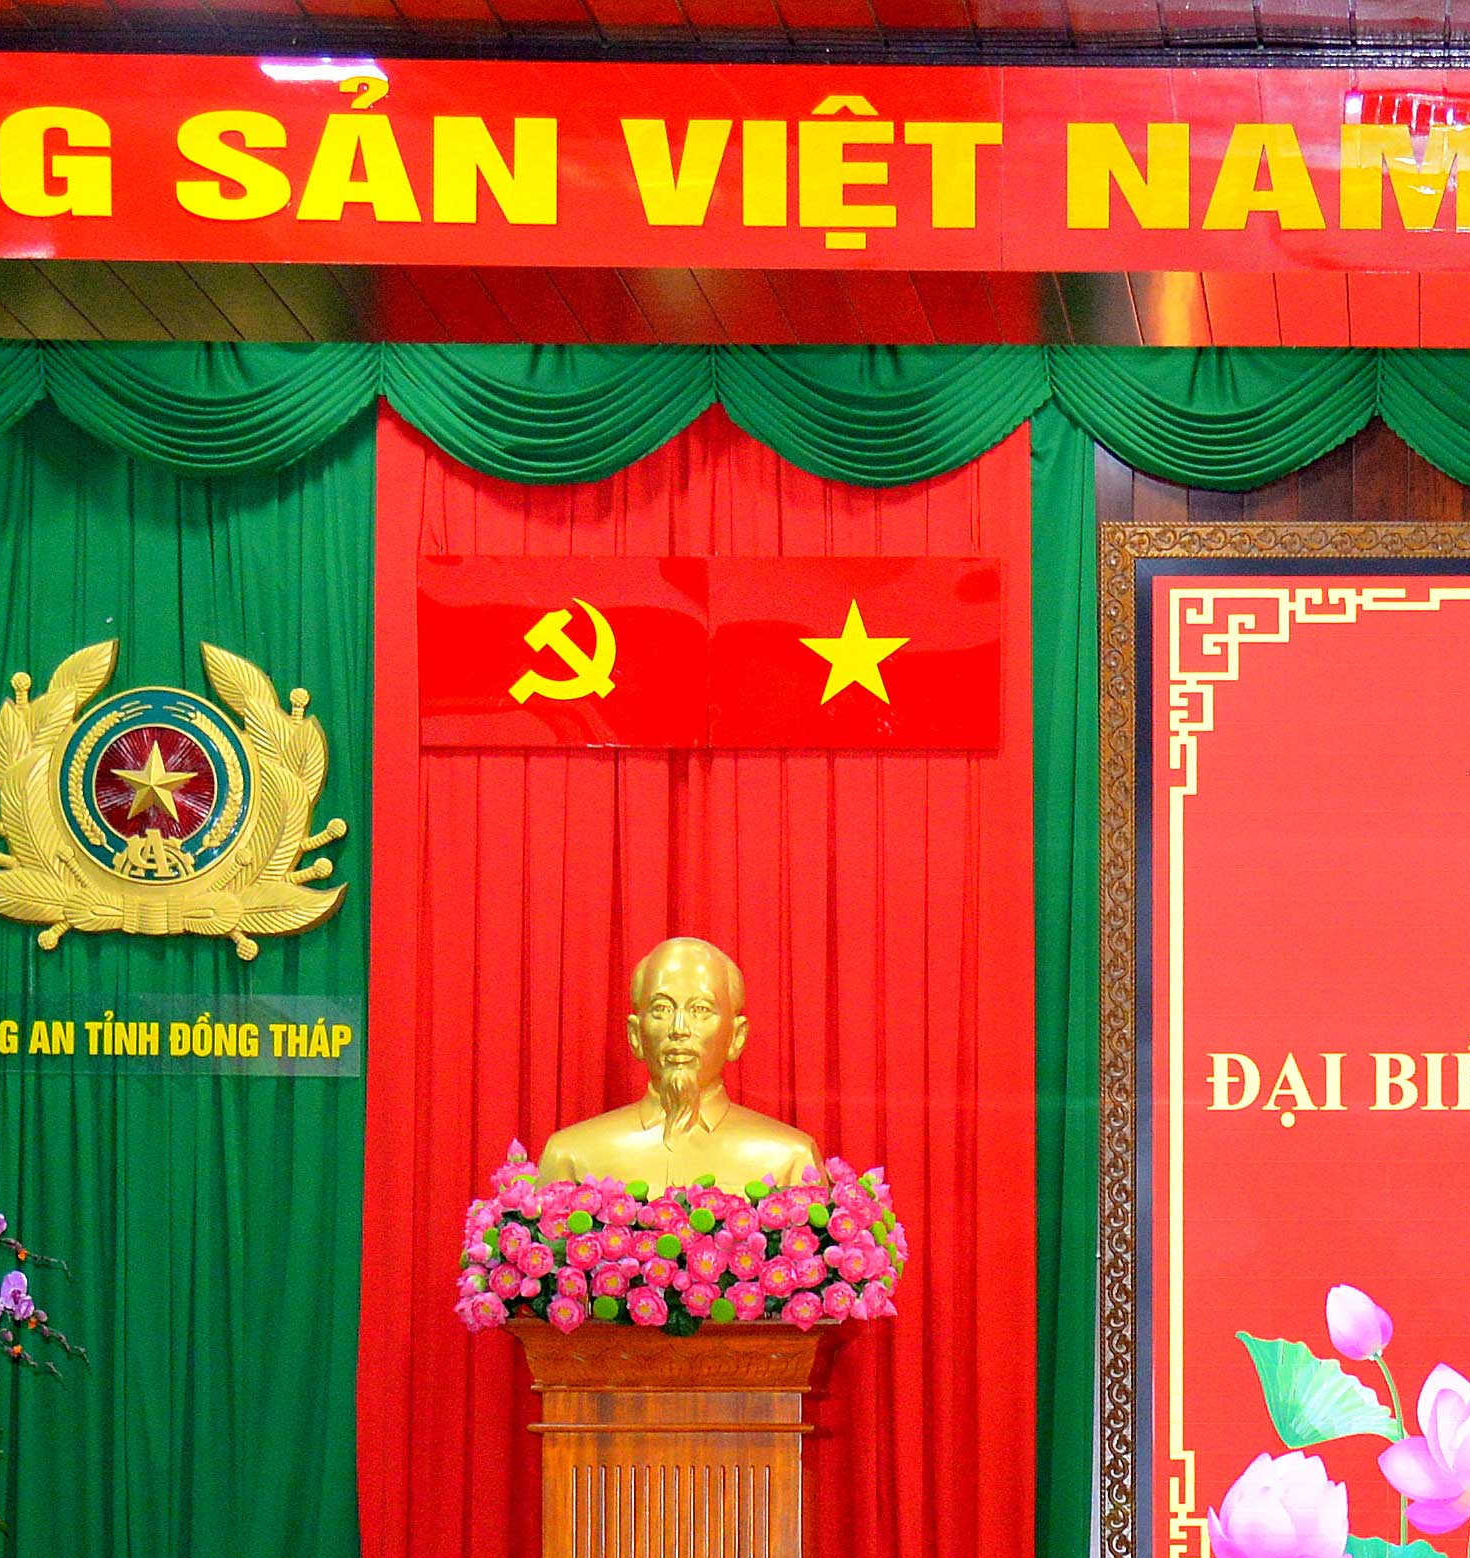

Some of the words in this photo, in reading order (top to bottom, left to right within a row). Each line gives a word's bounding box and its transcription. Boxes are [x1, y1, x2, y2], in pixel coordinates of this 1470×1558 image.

[176, 76, 557, 224] SẢN
[621, 96, 1002, 249] VIỆT
[29, 1021, 74, 1054] AN
[85, 1011, 159, 1055] TỈNH
[170, 1012, 258, 1057] ĐỒNG
[269, 1018, 351, 1057] THÁP
[1206, 1053, 1348, 1127] ĐẠI
